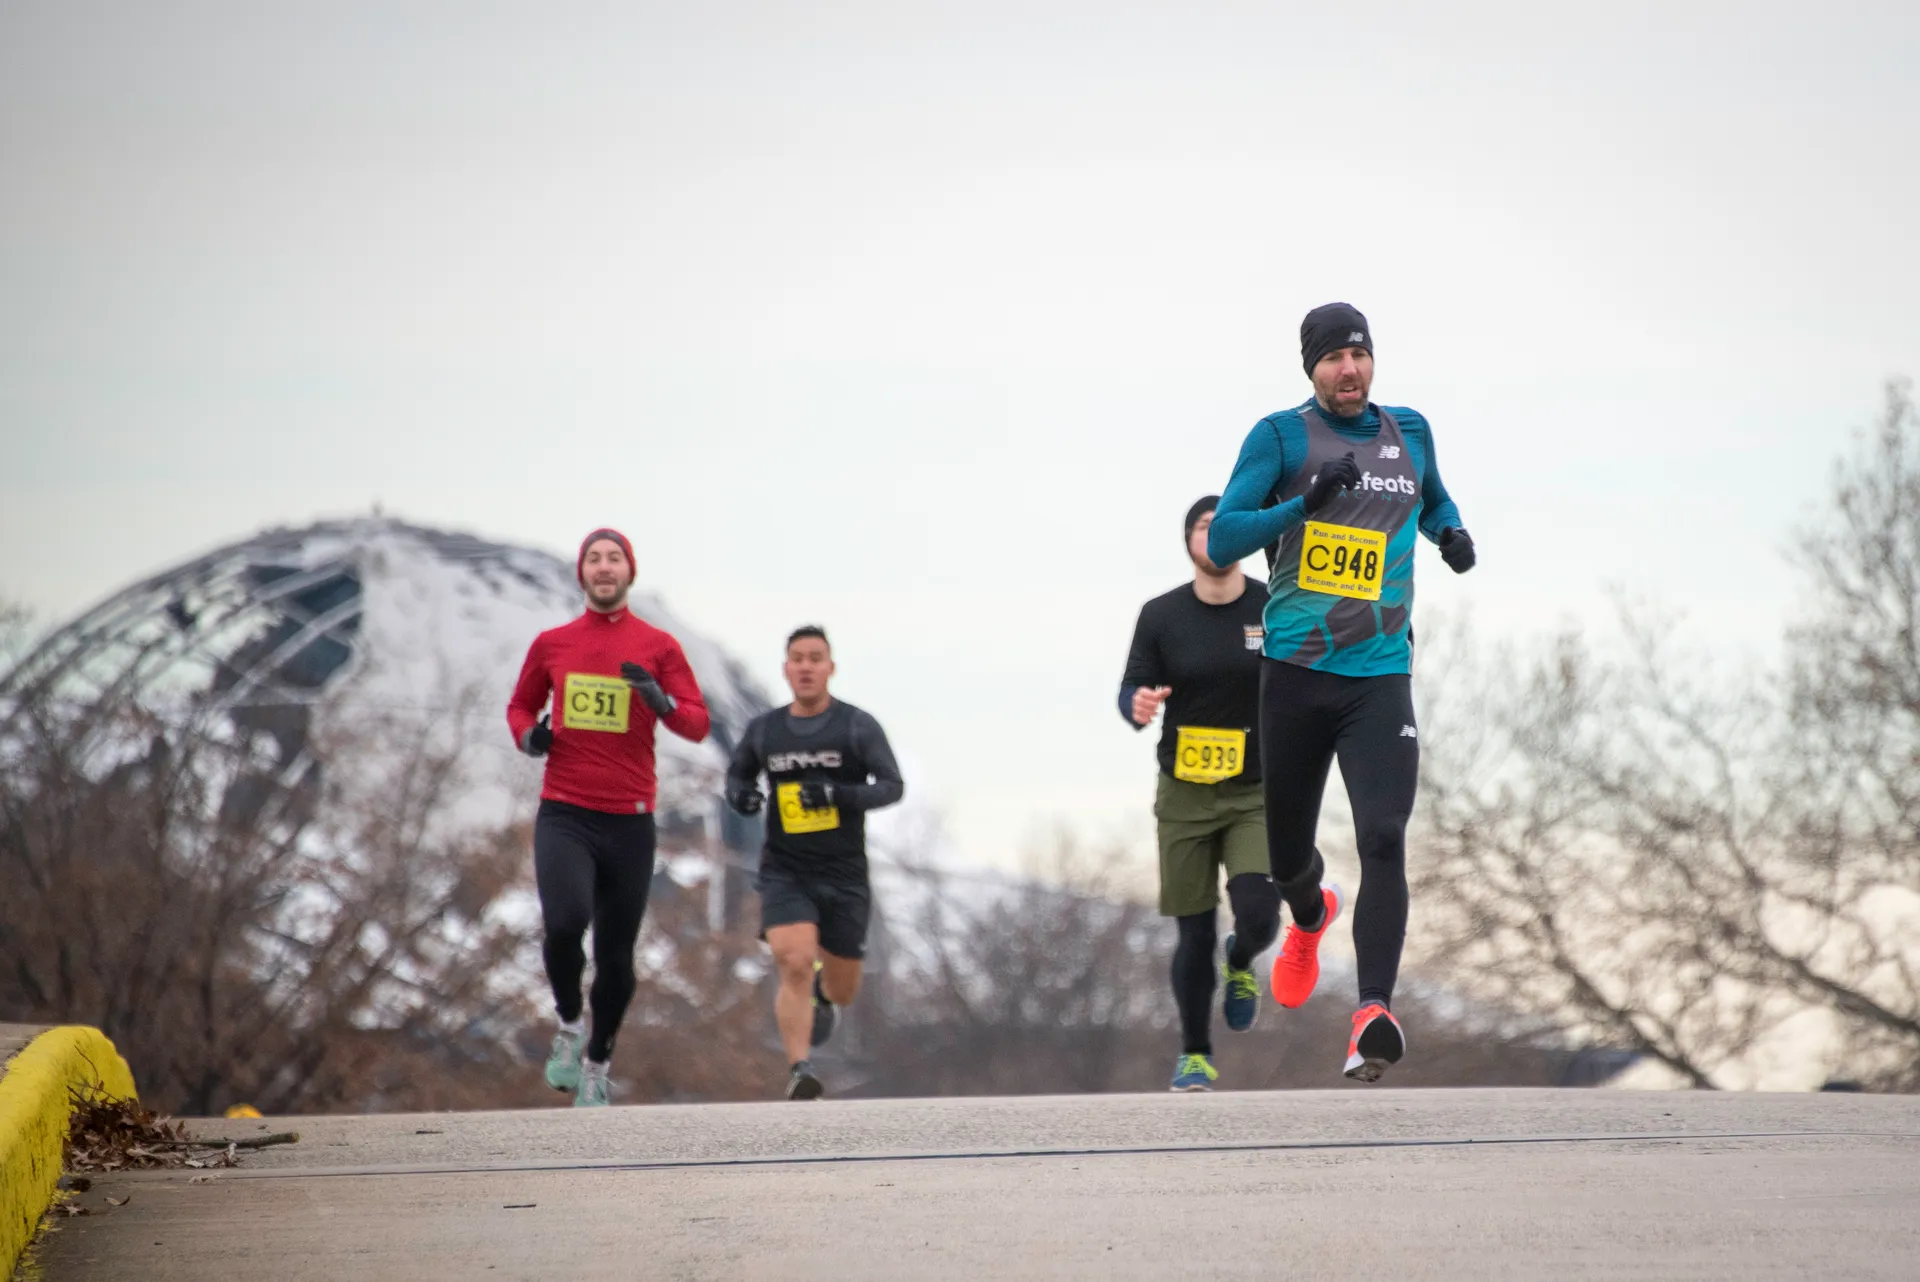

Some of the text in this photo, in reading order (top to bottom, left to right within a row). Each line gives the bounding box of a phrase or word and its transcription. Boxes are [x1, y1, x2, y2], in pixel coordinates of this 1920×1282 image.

[1378, 445, 1400, 459] NB
[1312, 528, 1379, 546] Run and Become
[1305, 575, 1373, 593] Become and Run
